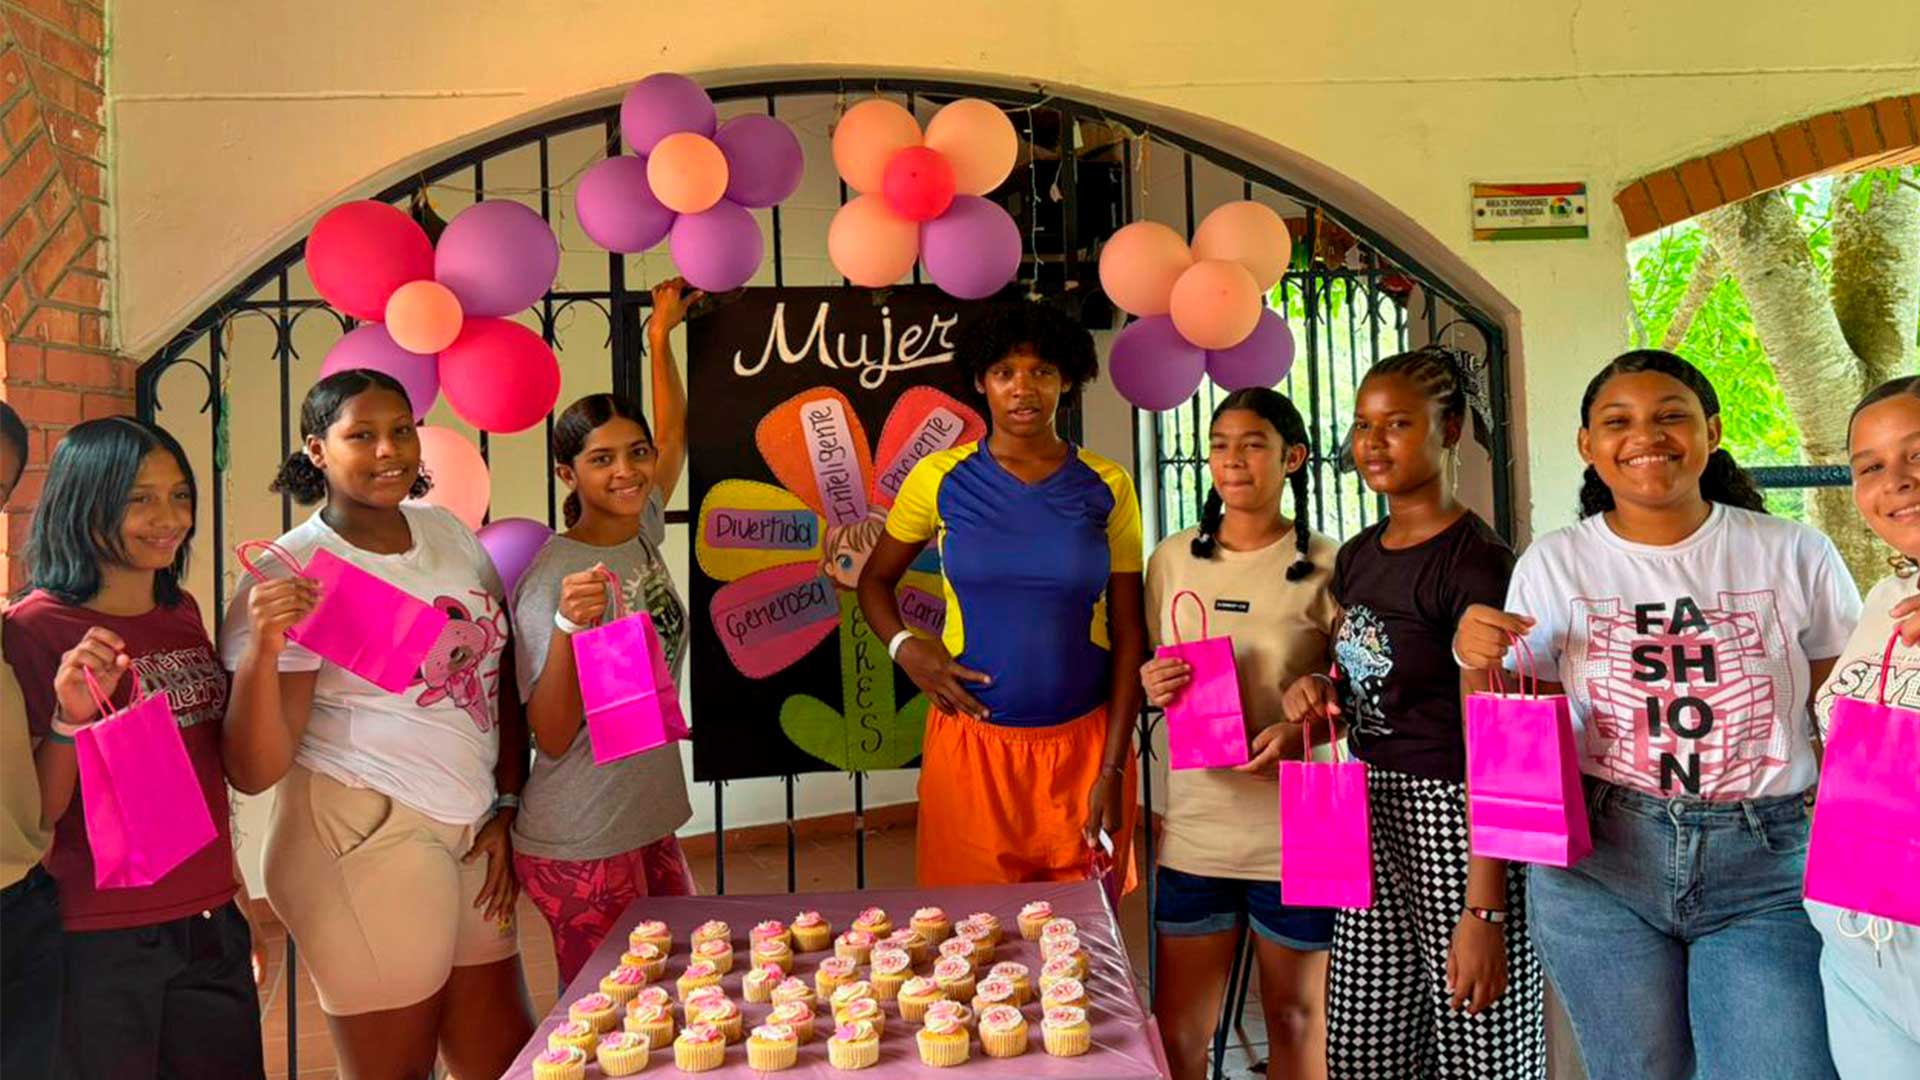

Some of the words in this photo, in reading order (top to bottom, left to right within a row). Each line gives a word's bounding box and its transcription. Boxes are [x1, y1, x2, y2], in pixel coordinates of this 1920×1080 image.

[733, 301, 959, 389] Mujer
[716, 513, 812, 547] Divertida
[725, 581, 828, 646] Generosa
